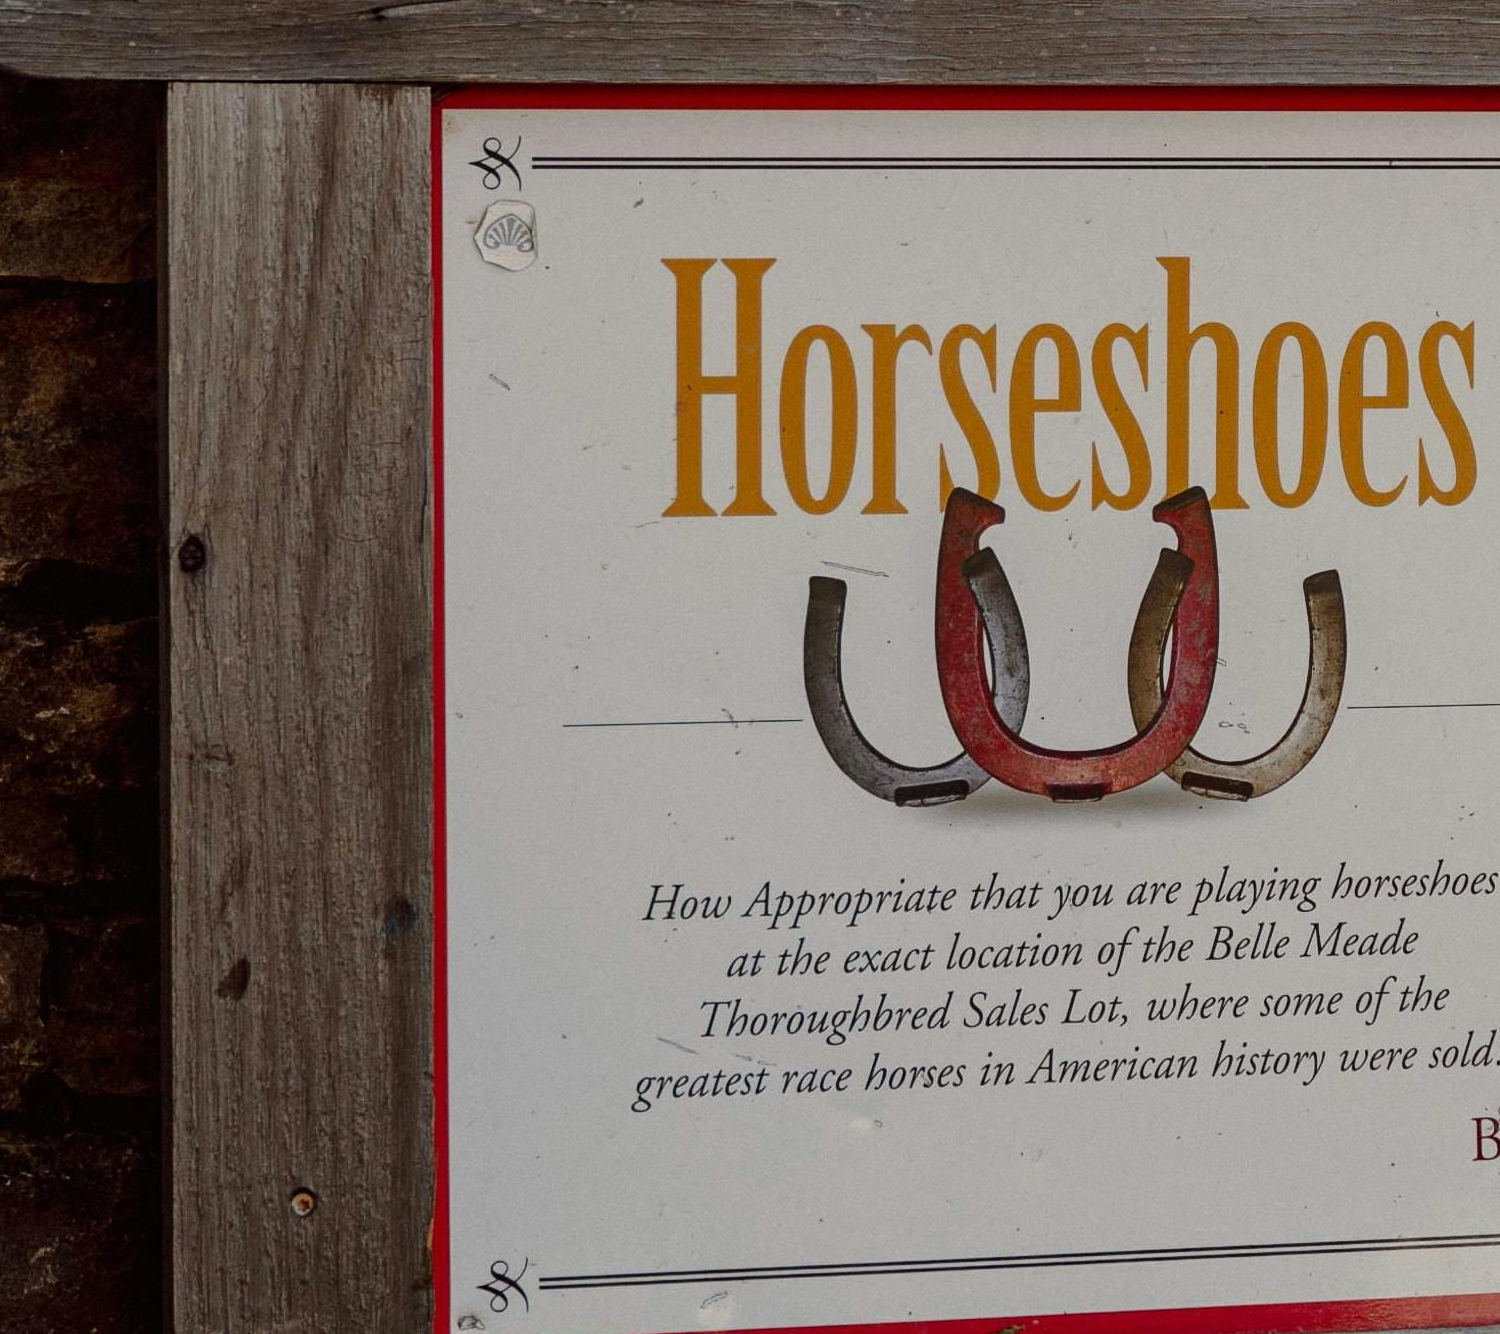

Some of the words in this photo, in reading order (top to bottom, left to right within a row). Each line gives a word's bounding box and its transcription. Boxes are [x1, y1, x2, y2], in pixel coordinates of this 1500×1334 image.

[661, 255, 1478, 517] Horseshoes
[641, 883, 731, 920] How
[740, 878, 956, 930] Appropriate
[969, 871, 1043, 910] that
[1046, 883, 1113, 920] you
[1126, 881, 1181, 905] are
[1186, 864, 1321, 916] playing
[1330, 858, 1498, 899] horseshoes
[726, 949, 765, 977] at
[777, 937, 830, 975] the
[843, 943, 935, 973] exact
[946, 931, 1082, 969] location
[1097, 925, 1140, 977] of
[1141, 924, 1193, 963] the
[1205, 921, 1290, 960] Belle
[1299, 917, 1419, 957] Meade
[700, 990, 953, 1045] Thoroughbred
[962, 988, 1049, 1028] Sales
[1060, 988, 1127, 1026] Lot,
[1146, 982, 1249, 1021] where
[1259, 992, 1343, 1017] some
[1355, 975, 1397, 1025] of
[1398, 974, 1450, 1012] the
[630, 1067, 770, 1112] greatest
[781, 1068, 852, 1093] race
[864, 1052, 966, 1090] horses
[979, 1051, 1014, 1086] in
[1024, 1045, 1197, 1084] American
[1211, 1039, 1325, 1086] history
[1339, 1047, 1417, 1072] were
